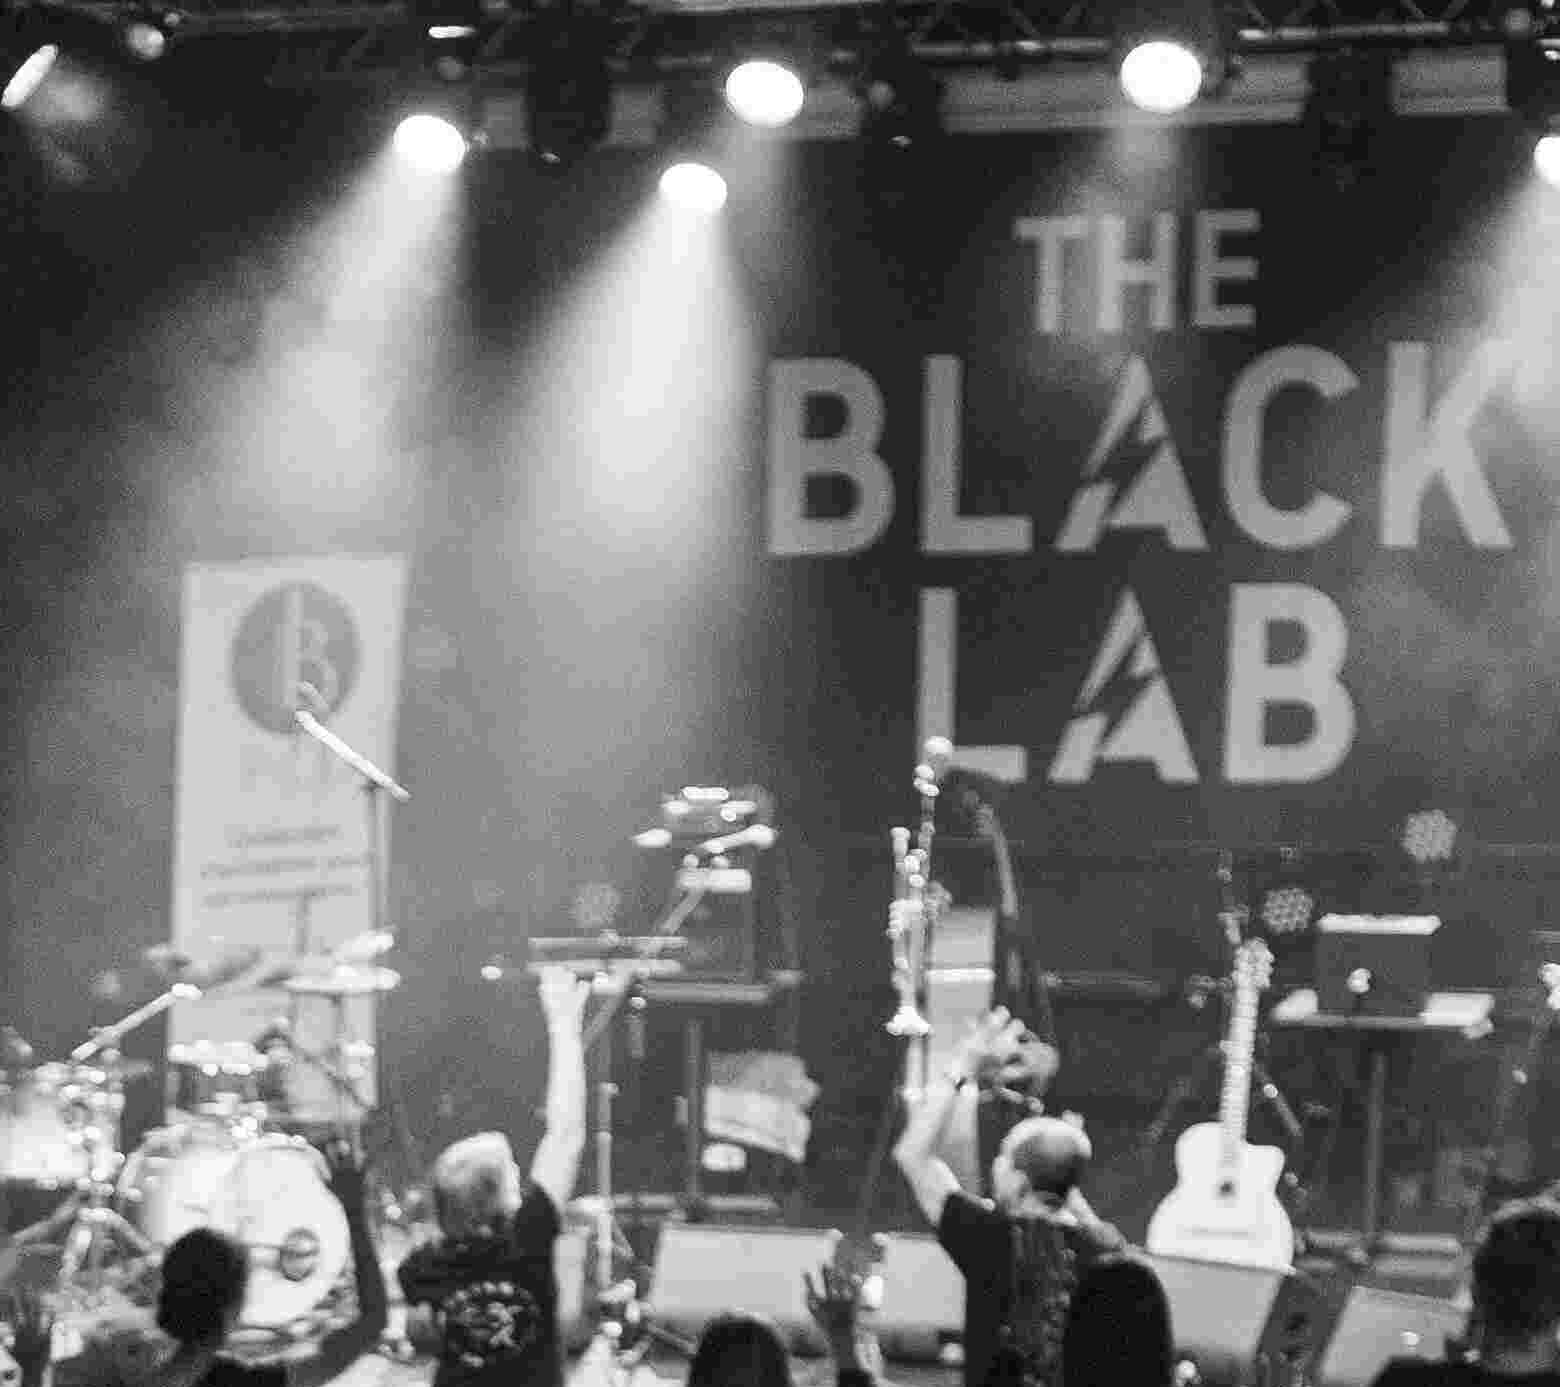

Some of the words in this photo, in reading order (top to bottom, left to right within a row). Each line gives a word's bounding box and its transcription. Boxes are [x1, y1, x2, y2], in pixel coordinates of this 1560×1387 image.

[1013, 208, 1261, 334] THE
[765, 340, 1520, 557] BLACK
[914, 583, 1357, 785] LAB
